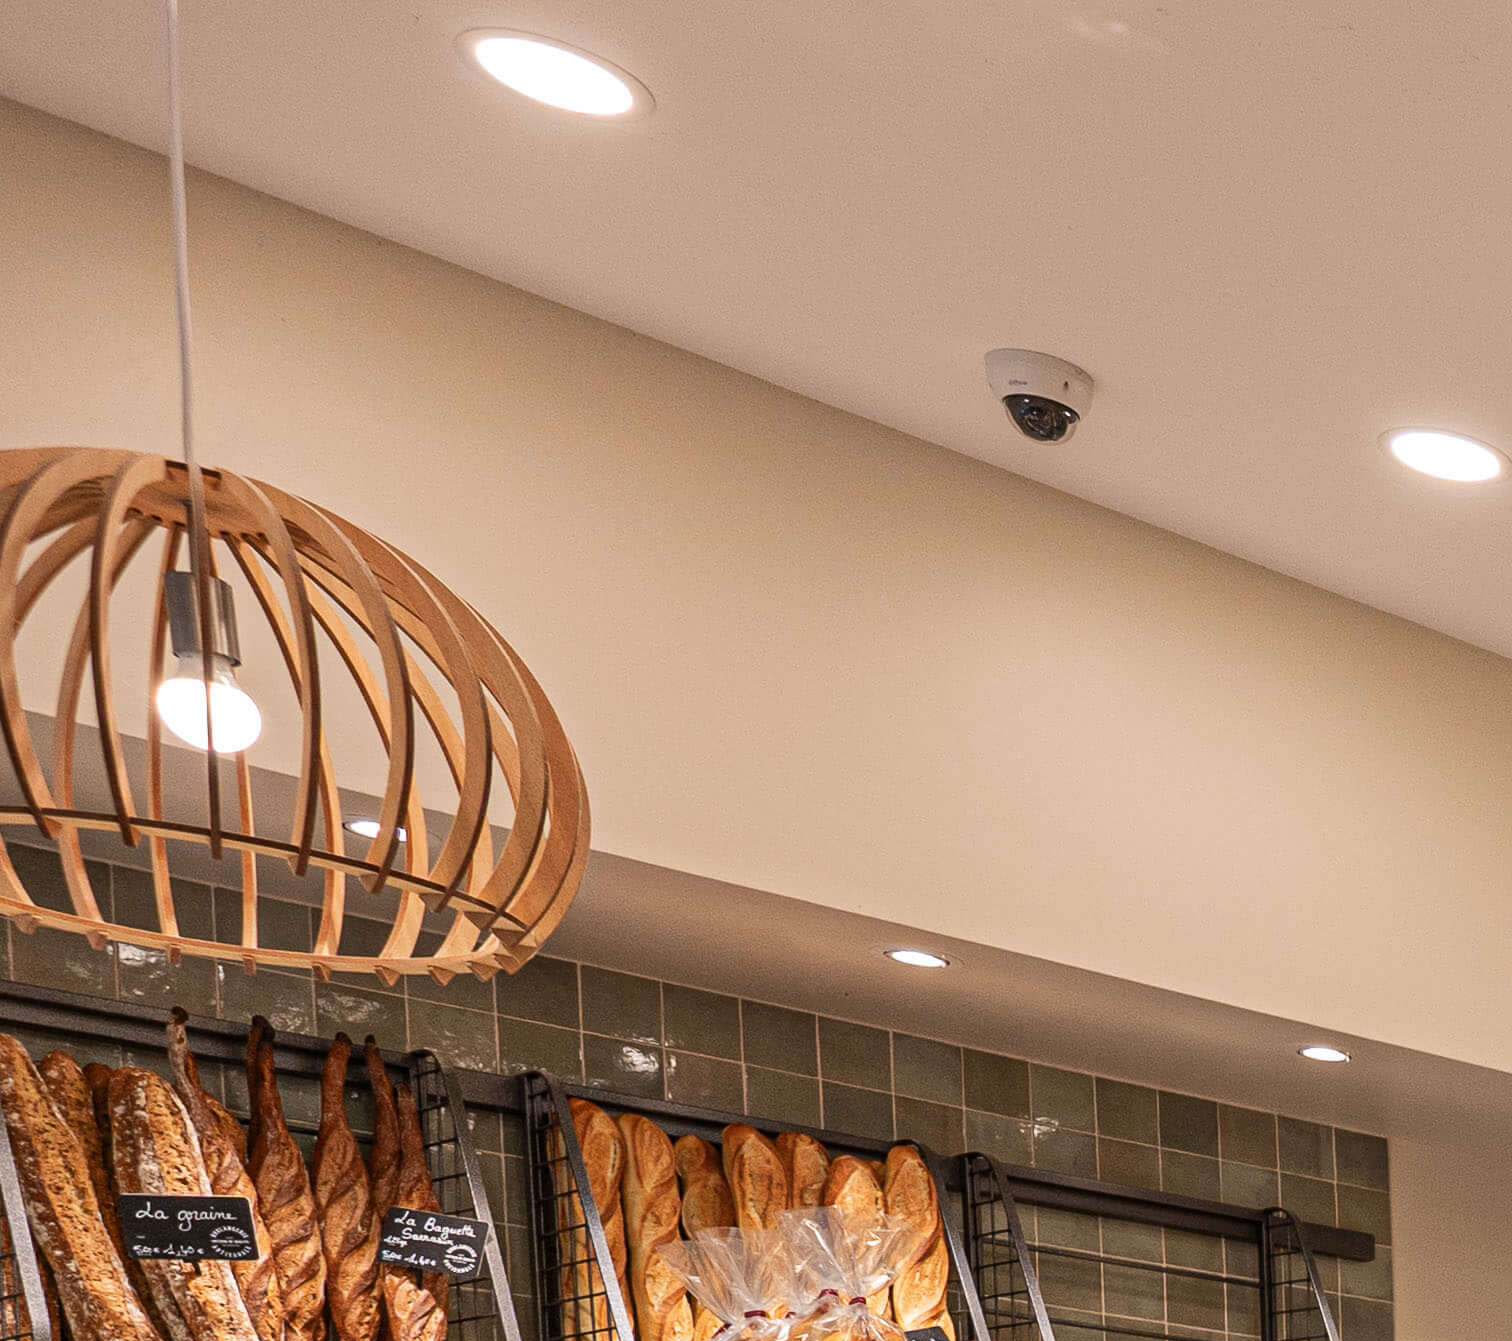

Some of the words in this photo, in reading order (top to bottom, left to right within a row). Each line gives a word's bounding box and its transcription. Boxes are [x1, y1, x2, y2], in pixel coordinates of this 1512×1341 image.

[135, 1201, 169, 1219] La
[177, 1206, 238, 1232] graine
[394, 1210, 416, 1227] La
